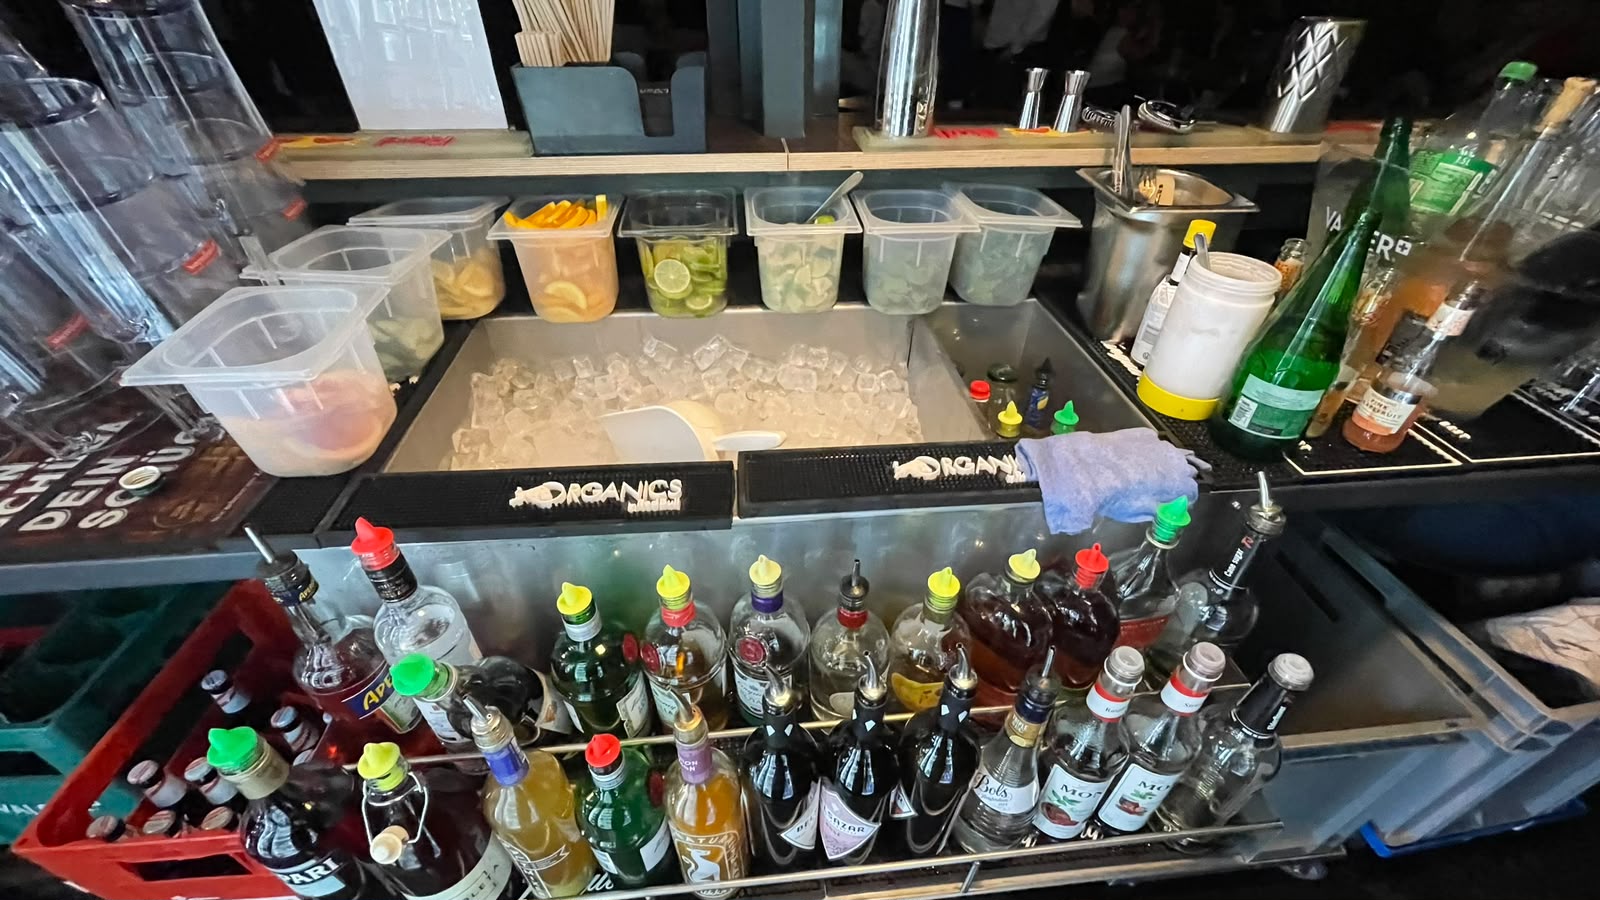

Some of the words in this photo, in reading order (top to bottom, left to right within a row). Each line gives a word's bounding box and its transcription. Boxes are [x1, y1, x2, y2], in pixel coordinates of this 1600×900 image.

[907, 454, 1018, 480] ORGANI
[19, 455, 140, 531] DEIN
[975, 774, 1009, 798] Bols
